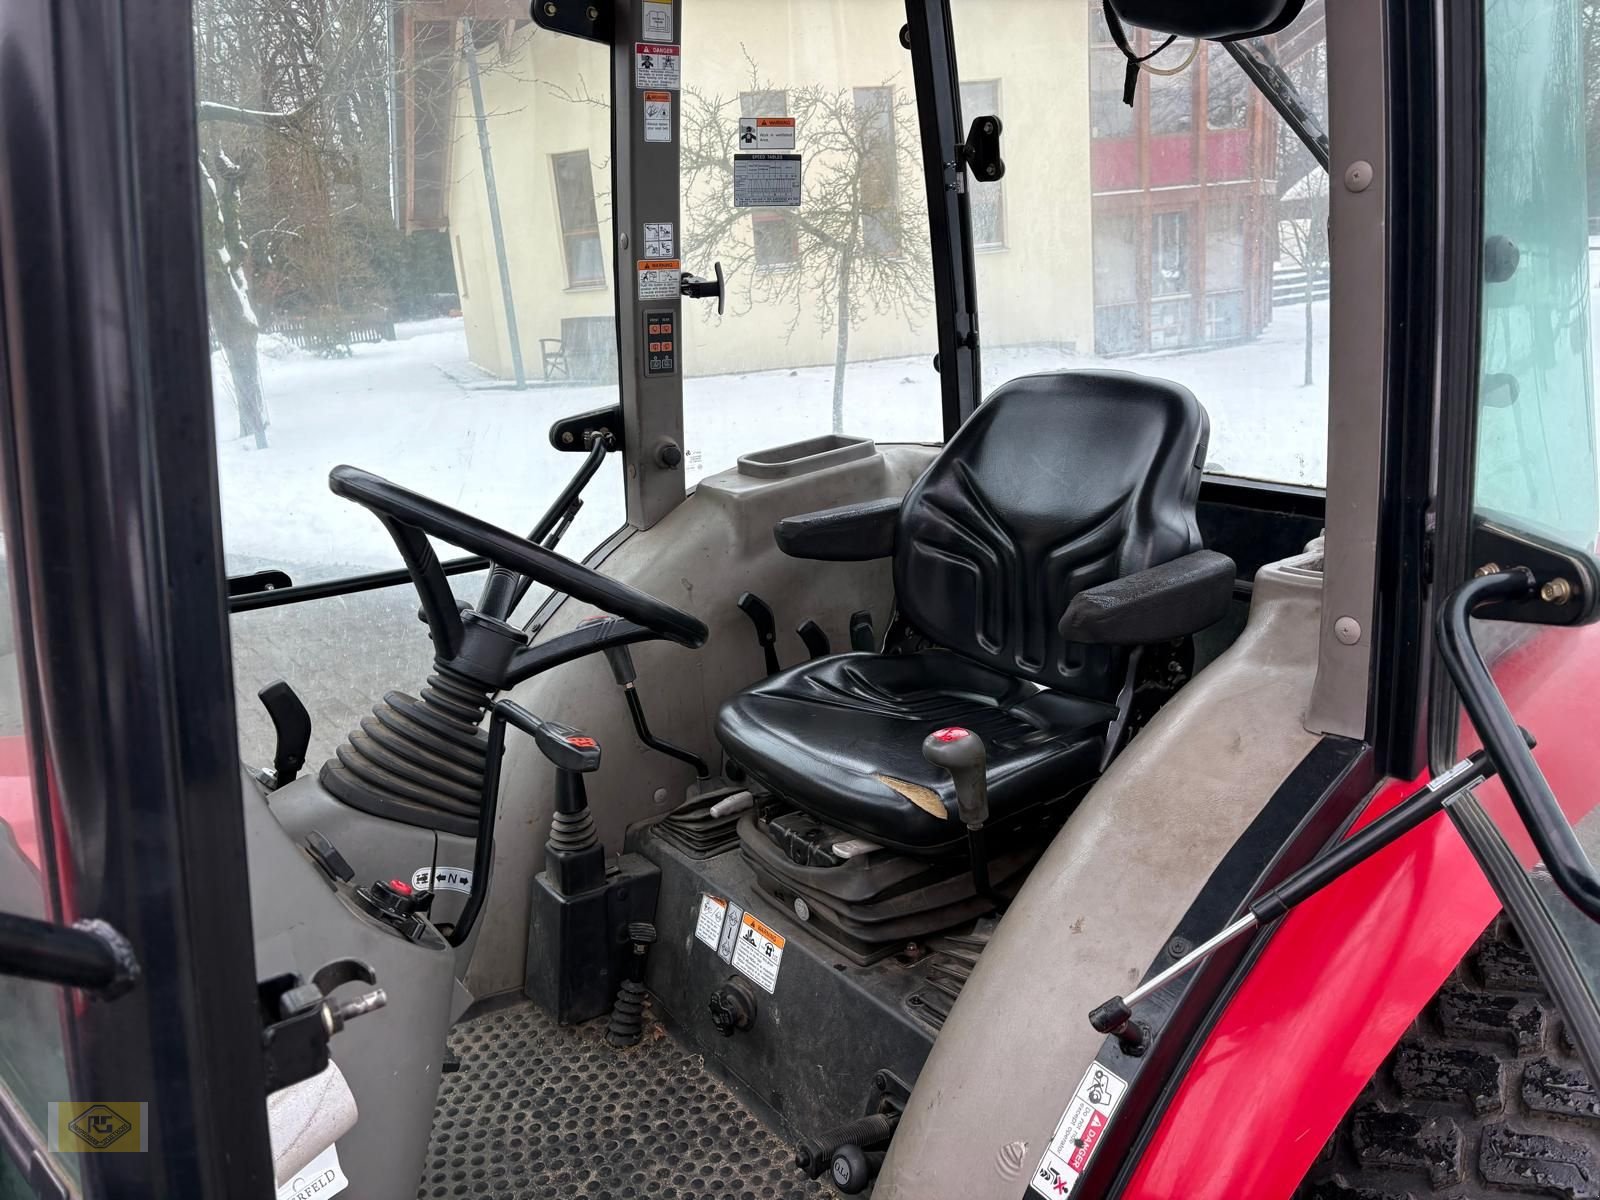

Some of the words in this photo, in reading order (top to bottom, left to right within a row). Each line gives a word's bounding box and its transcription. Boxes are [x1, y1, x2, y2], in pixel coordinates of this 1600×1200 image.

[448, 873, 458, 883] N
[757, 923, 777, 943] WARNING
[1072, 1129, 1097, 1168] DANGER
[289, 1169, 336, 1200] RFELD
